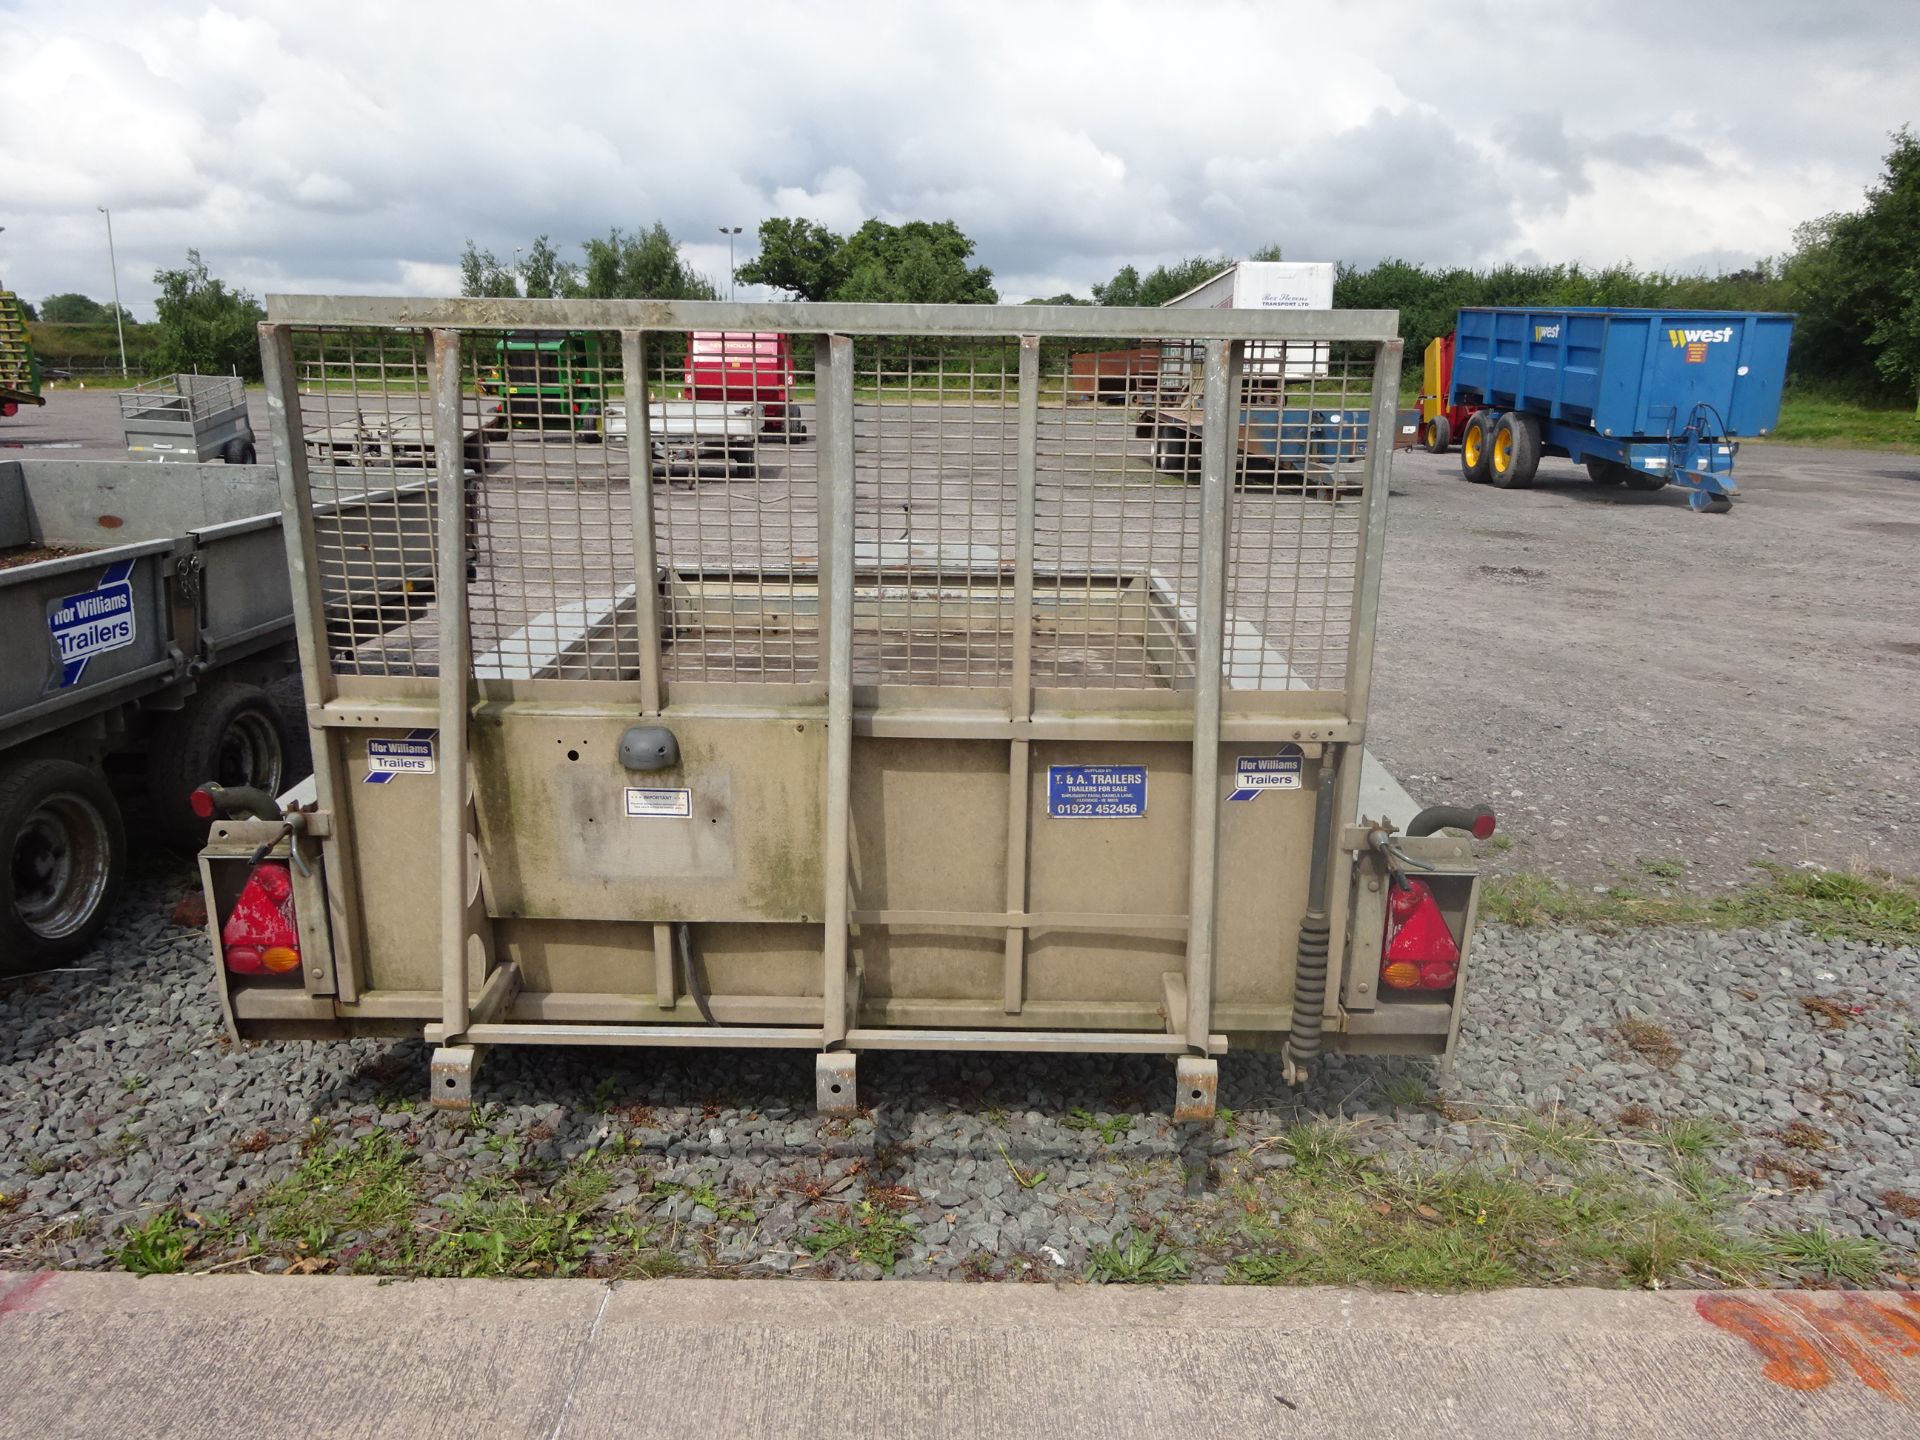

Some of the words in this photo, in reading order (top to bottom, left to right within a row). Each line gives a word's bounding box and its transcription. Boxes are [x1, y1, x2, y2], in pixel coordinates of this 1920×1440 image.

[76, 593, 128, 619] Williams
[57, 621, 130, 655] Trailers
[371, 742, 387, 753] Ifor
[387, 743, 429, 754] Williams
[376, 757, 426, 769] Trailers
[1240, 760, 1257, 770] Ifor
[1257, 760, 1298, 770] Williams
[1066, 774, 1074, 784] &
[1091, 774, 1142, 784] TRAILERS
[1244, 775, 1292, 784] Trailers
[1057, 804, 1093, 814] 01922
[1095, 804, 1138, 814] 452456
